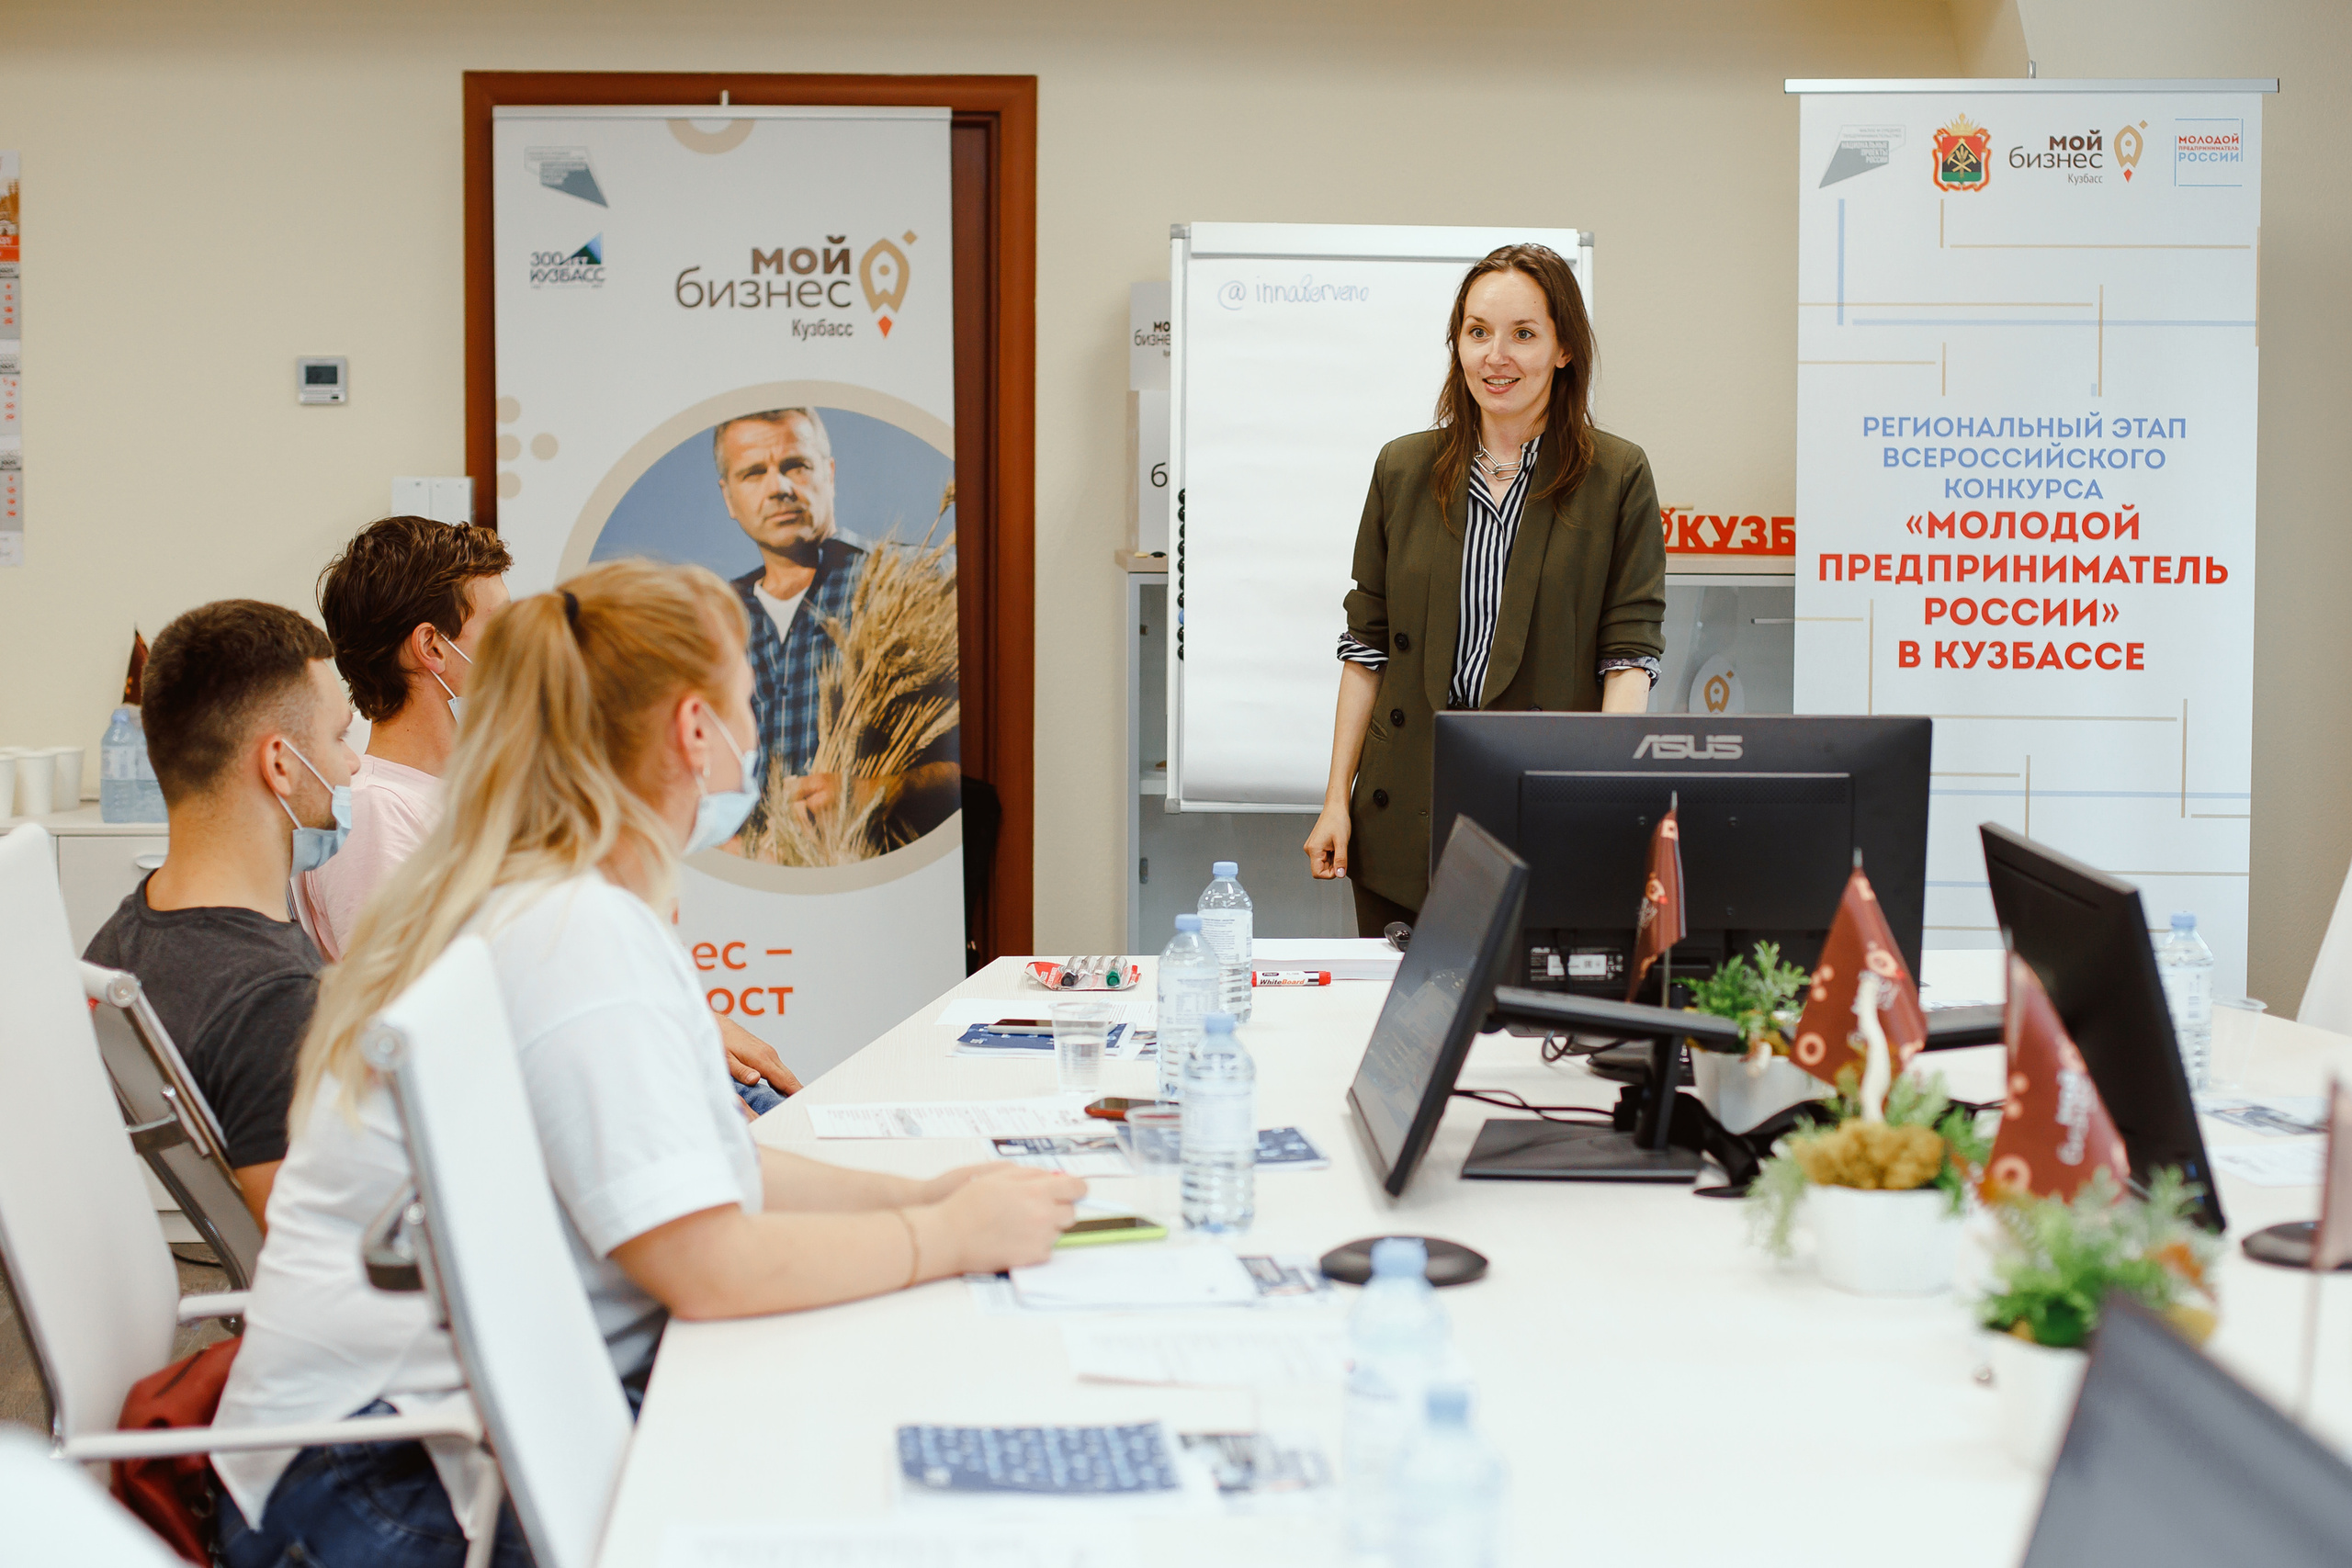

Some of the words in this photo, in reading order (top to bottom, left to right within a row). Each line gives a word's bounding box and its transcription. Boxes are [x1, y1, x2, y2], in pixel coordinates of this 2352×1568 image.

[2178, 133, 2239, 144] МОЛОДОЙ
[2008, 146, 2103, 169] бизнес
[2178, 152, 2239, 163] РОССИИ
[2067, 173, 2103, 186] Кузбасс
[675, 265, 852, 309] бизнес
[792, 319, 854, 341] Кузбасс
[1134, 329, 1170, 346] бизне
[1863, 412, 2104, 438] РЕГИОНАЛЬНЫЙ
[2111, 417, 2187, 439] ЭТАП
[1883, 442, 2166, 469] ВСЕРОССИЙСКОГО
[1944, 478, 2104, 500] КОНКУРСА
[1677, 514, 1795, 556] КУЗБ
[1905, 504, 2140, 542] «МОЛОДОЙ
[1818, 553, 2229, 585] ПРЕДПРИНИМАТЕЛЬ
[1924, 597, 2120, 627] РОССИИ»
[1898, 640, 1921, 669] В
[1934, 640, 2145, 671] КУЗБАССЕ
[1633, 734, 1744, 760] ASUS
